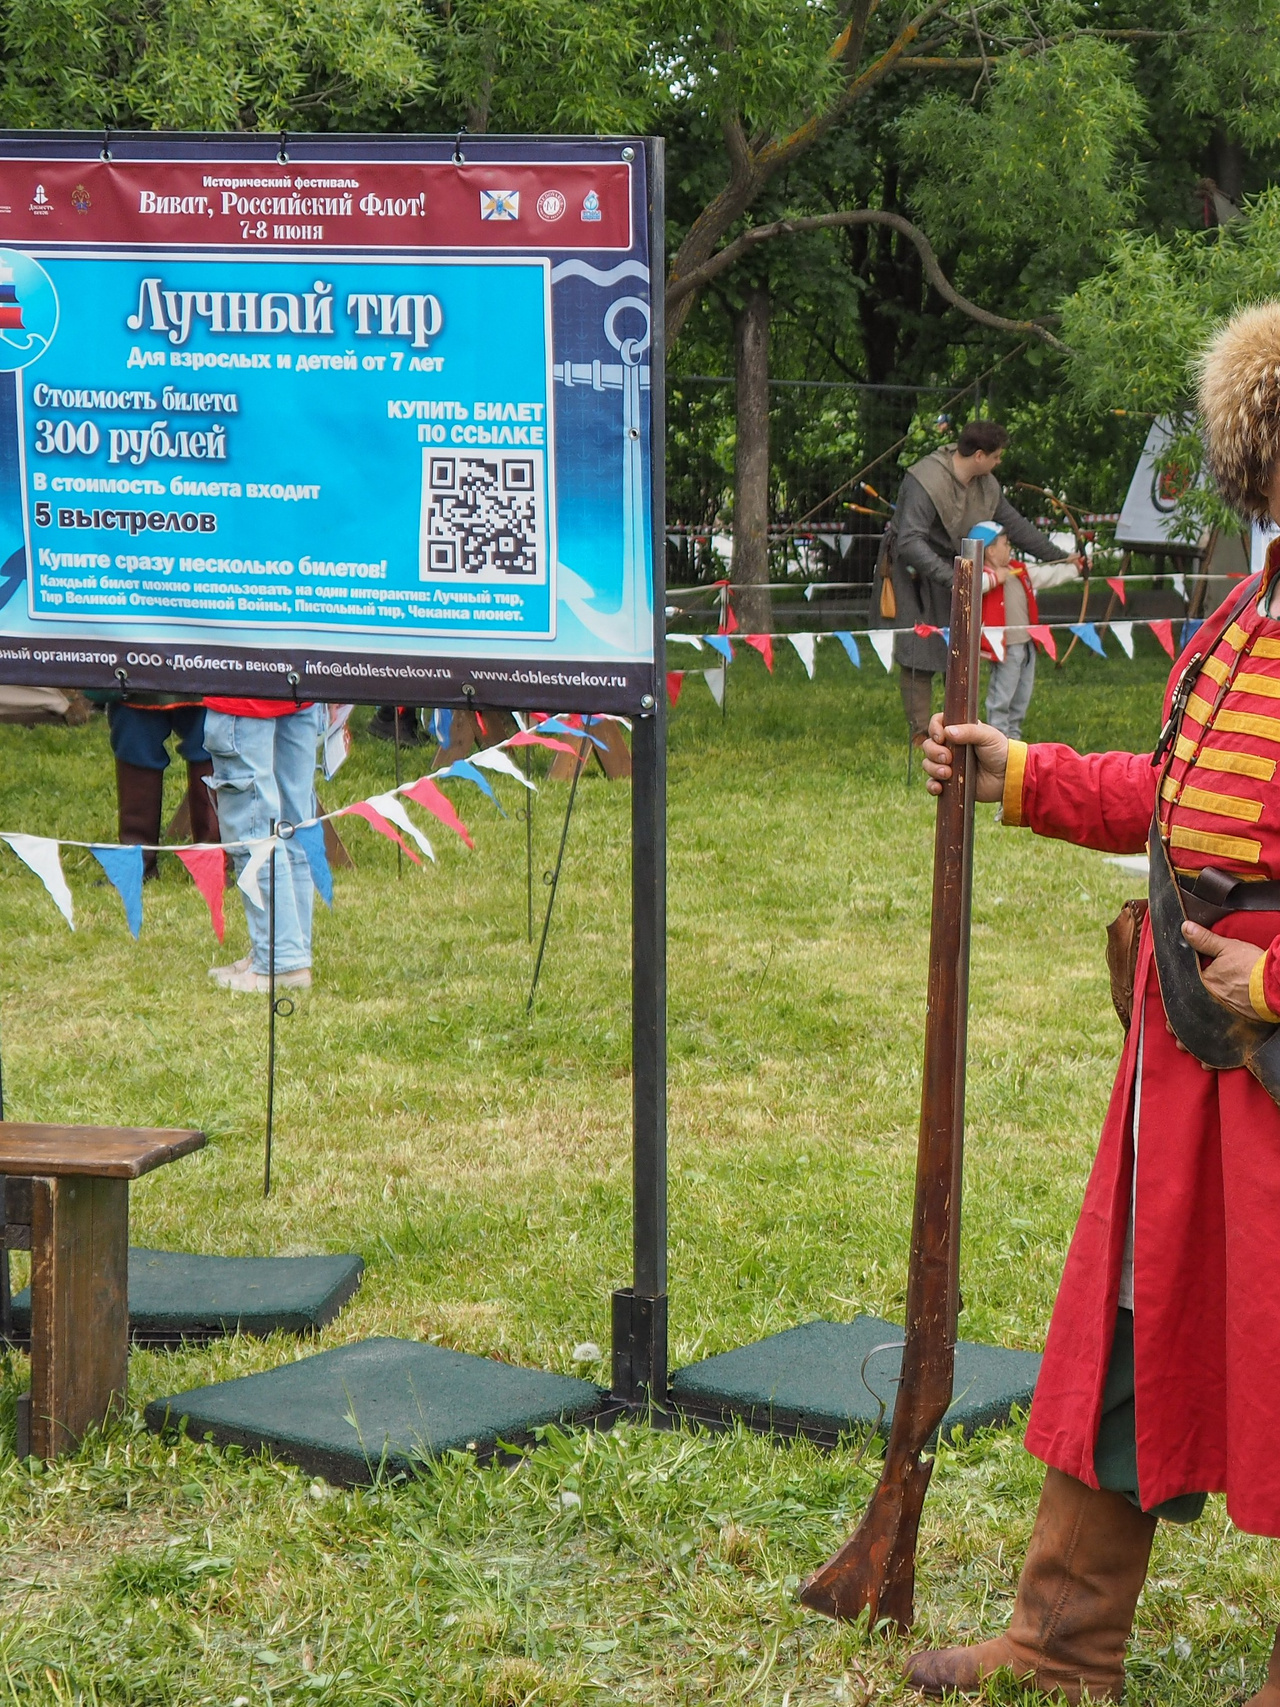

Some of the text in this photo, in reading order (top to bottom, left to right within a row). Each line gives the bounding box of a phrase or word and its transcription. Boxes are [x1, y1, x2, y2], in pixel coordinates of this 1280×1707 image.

[203, 175, 360, 190] Исторический фестиваль
[138, 190, 426, 218] Виват, Российский Флот!
[240, 220, 324, 240] 7-8 июня
[126, 278, 442, 348] Лучный тир
[126, 347, 445, 372] Для взрослых и детей от 7 лет
[33, 383, 239, 412] Стоимость билета
[387, 400, 544, 421] КУПИТЬ БИЛЕТ
[35, 419, 227, 465] 300 рублей
[417, 423, 544, 445] ПО ССЫЛКЕ
[33, 472, 320, 501] В стоимость билета входит
[34, 501, 217, 537] 5 выстрелов
[38, 548, 387, 579] Купите сразу несколько билетов!
[40, 574, 524, 607] Каждый билет можно использовать на один интерактив: Лучный тир,
[40, 590, 524, 622] Тир Великой Отечественной Войны, Пистольный тир, Чеканка монет.
[33, 649, 117, 667] организатор
[126, 651, 163, 667] ООО
[165, 653, 243, 672] «Доблесть
[245, 659, 293, 673] веков»
[305, 659, 452, 680] info@doblestvekov.ru
[470, 667, 627, 688] www.doblestvekov.ru
